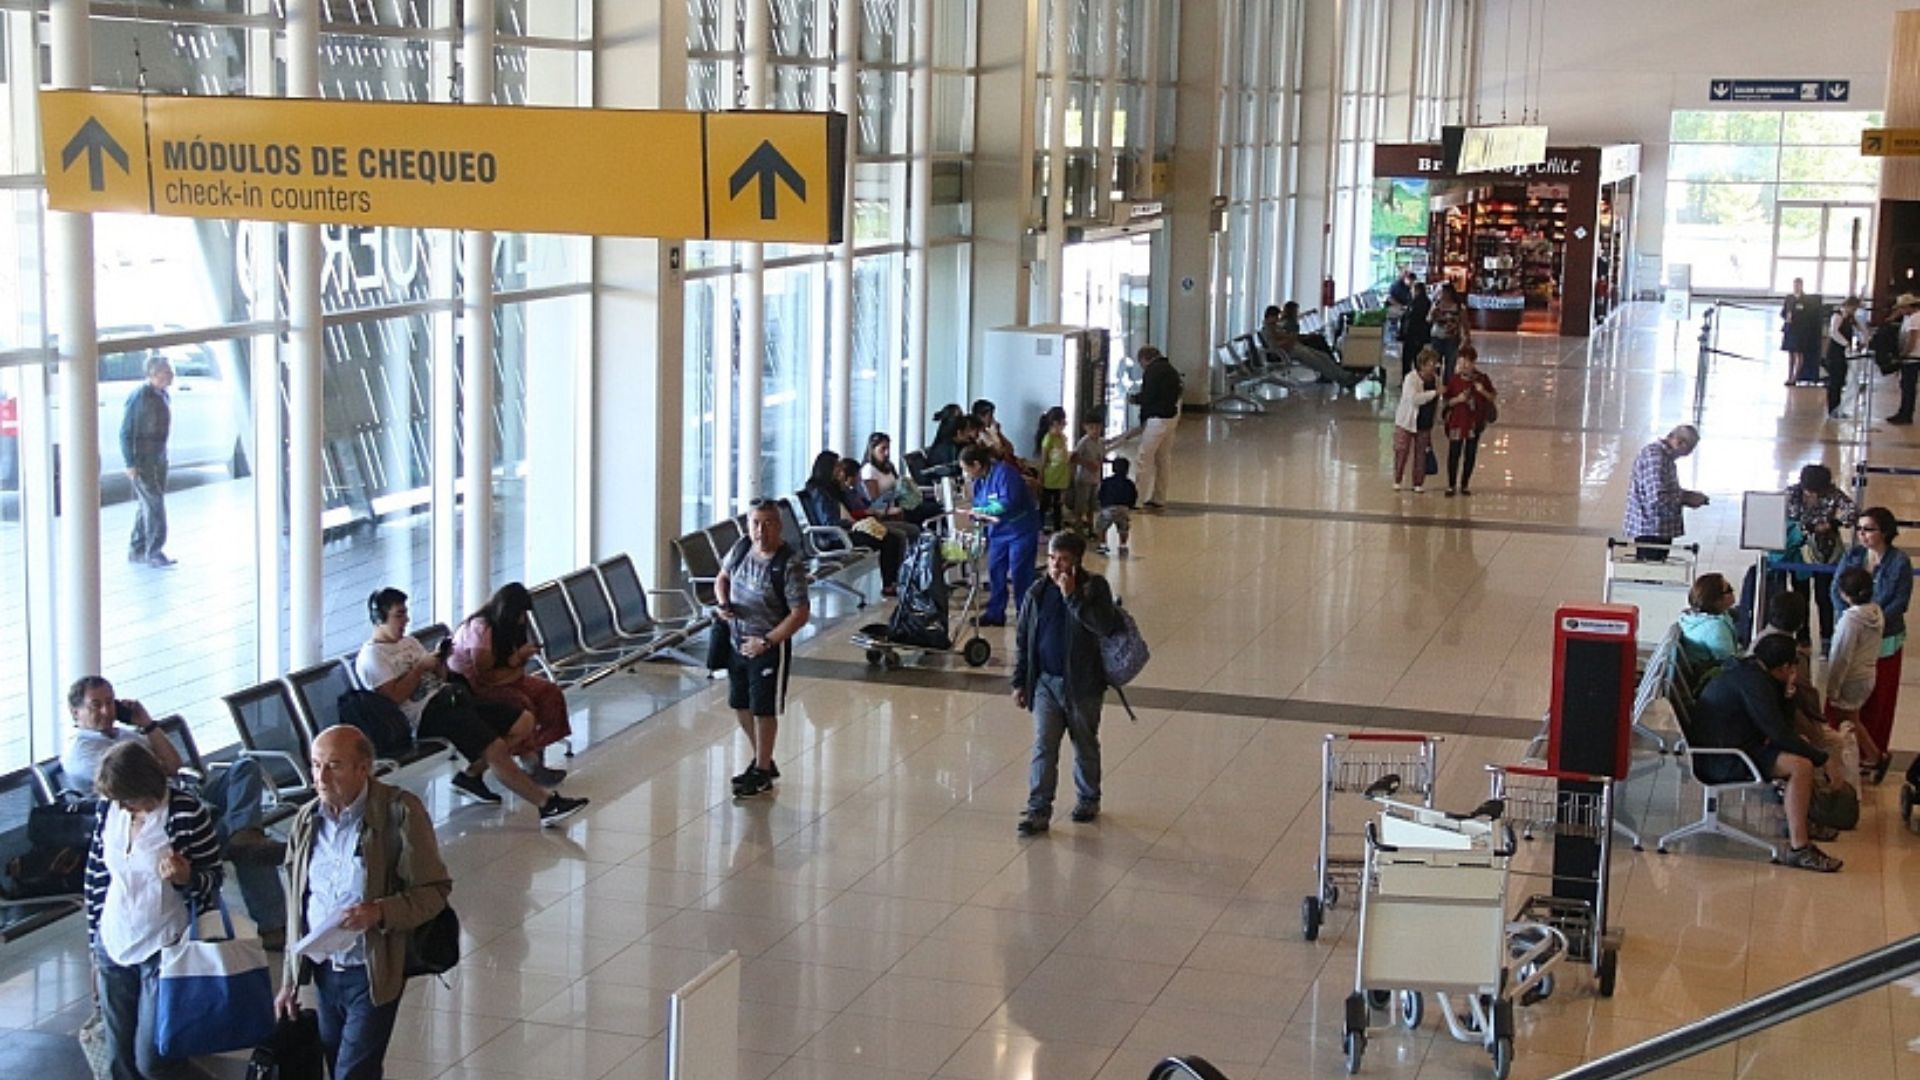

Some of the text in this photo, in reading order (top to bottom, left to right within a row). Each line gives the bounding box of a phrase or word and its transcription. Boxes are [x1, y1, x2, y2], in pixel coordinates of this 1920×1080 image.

[163, 135, 497, 184] MÓDULOS DE CHEQUEO
[165, 177, 372, 213] check-in counters
